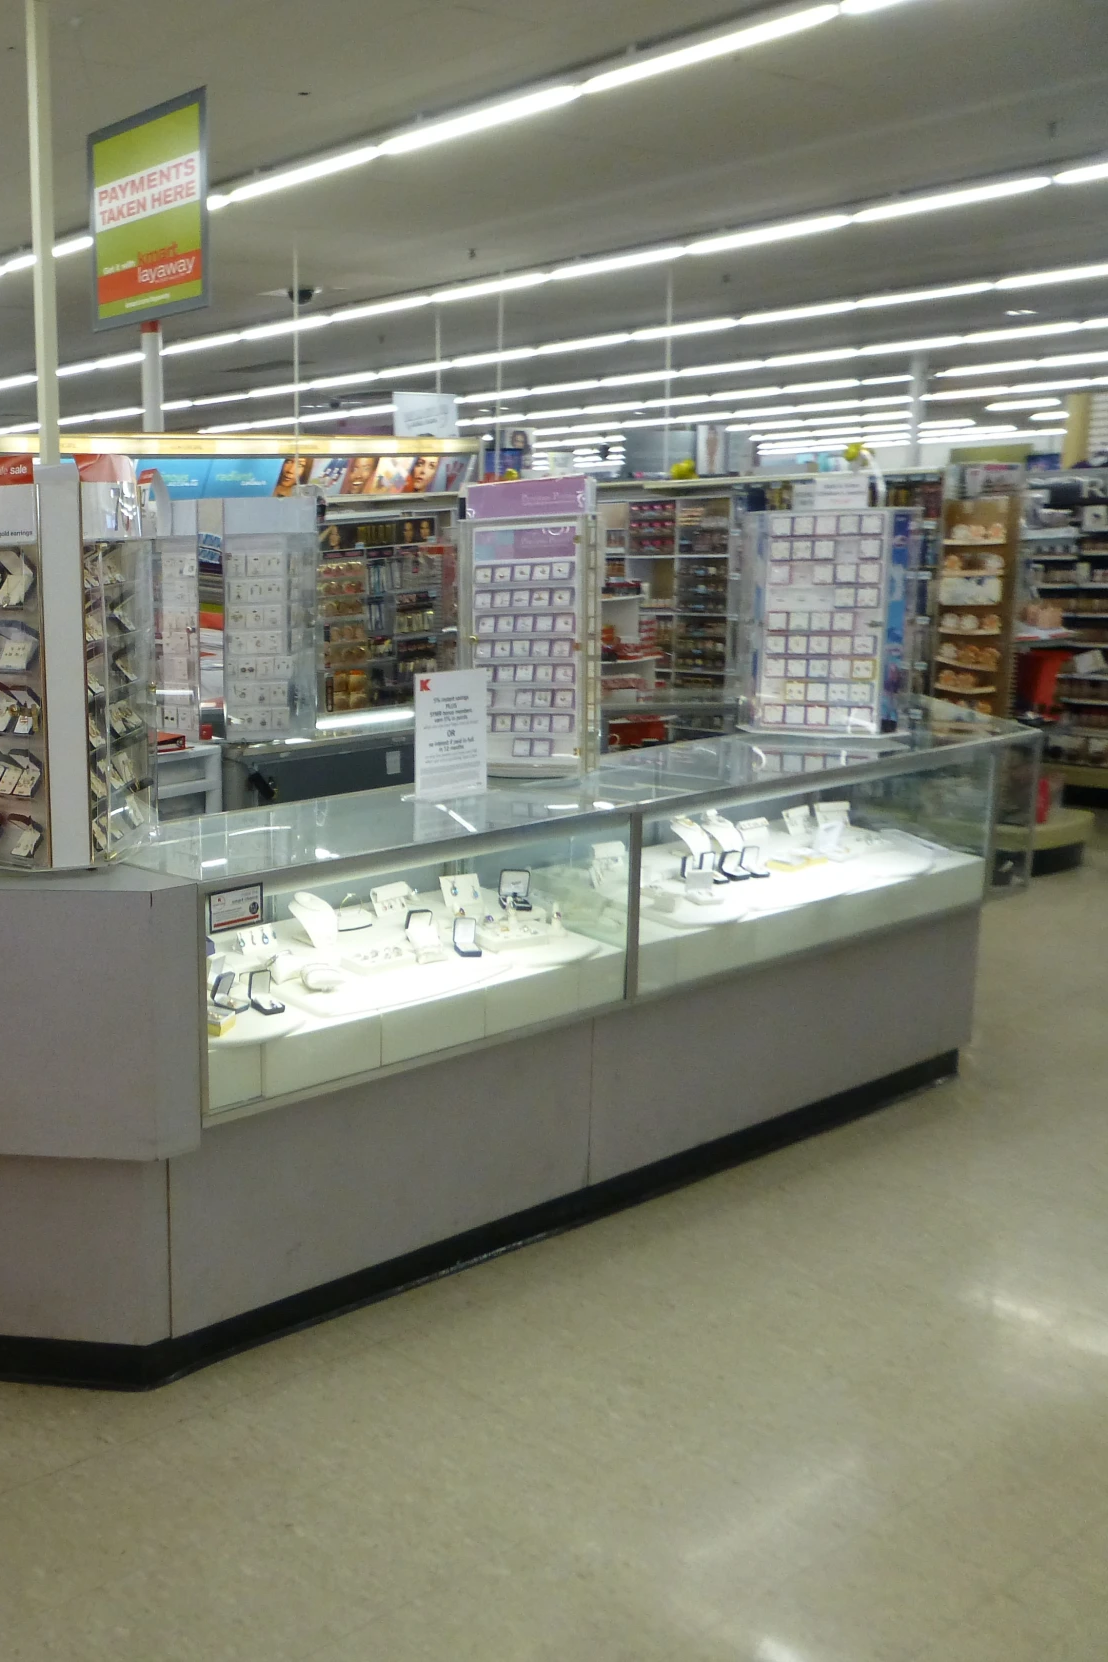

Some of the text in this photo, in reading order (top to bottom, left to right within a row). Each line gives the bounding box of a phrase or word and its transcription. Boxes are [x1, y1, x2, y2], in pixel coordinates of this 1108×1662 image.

[98, 157, 196, 207] PAYMENTS
[99, 180, 196, 226] TAKEN HERE
[137, 256, 195, 283] layaway
[10, 464, 27, 475] sale
[420, 679, 431, 691] K
